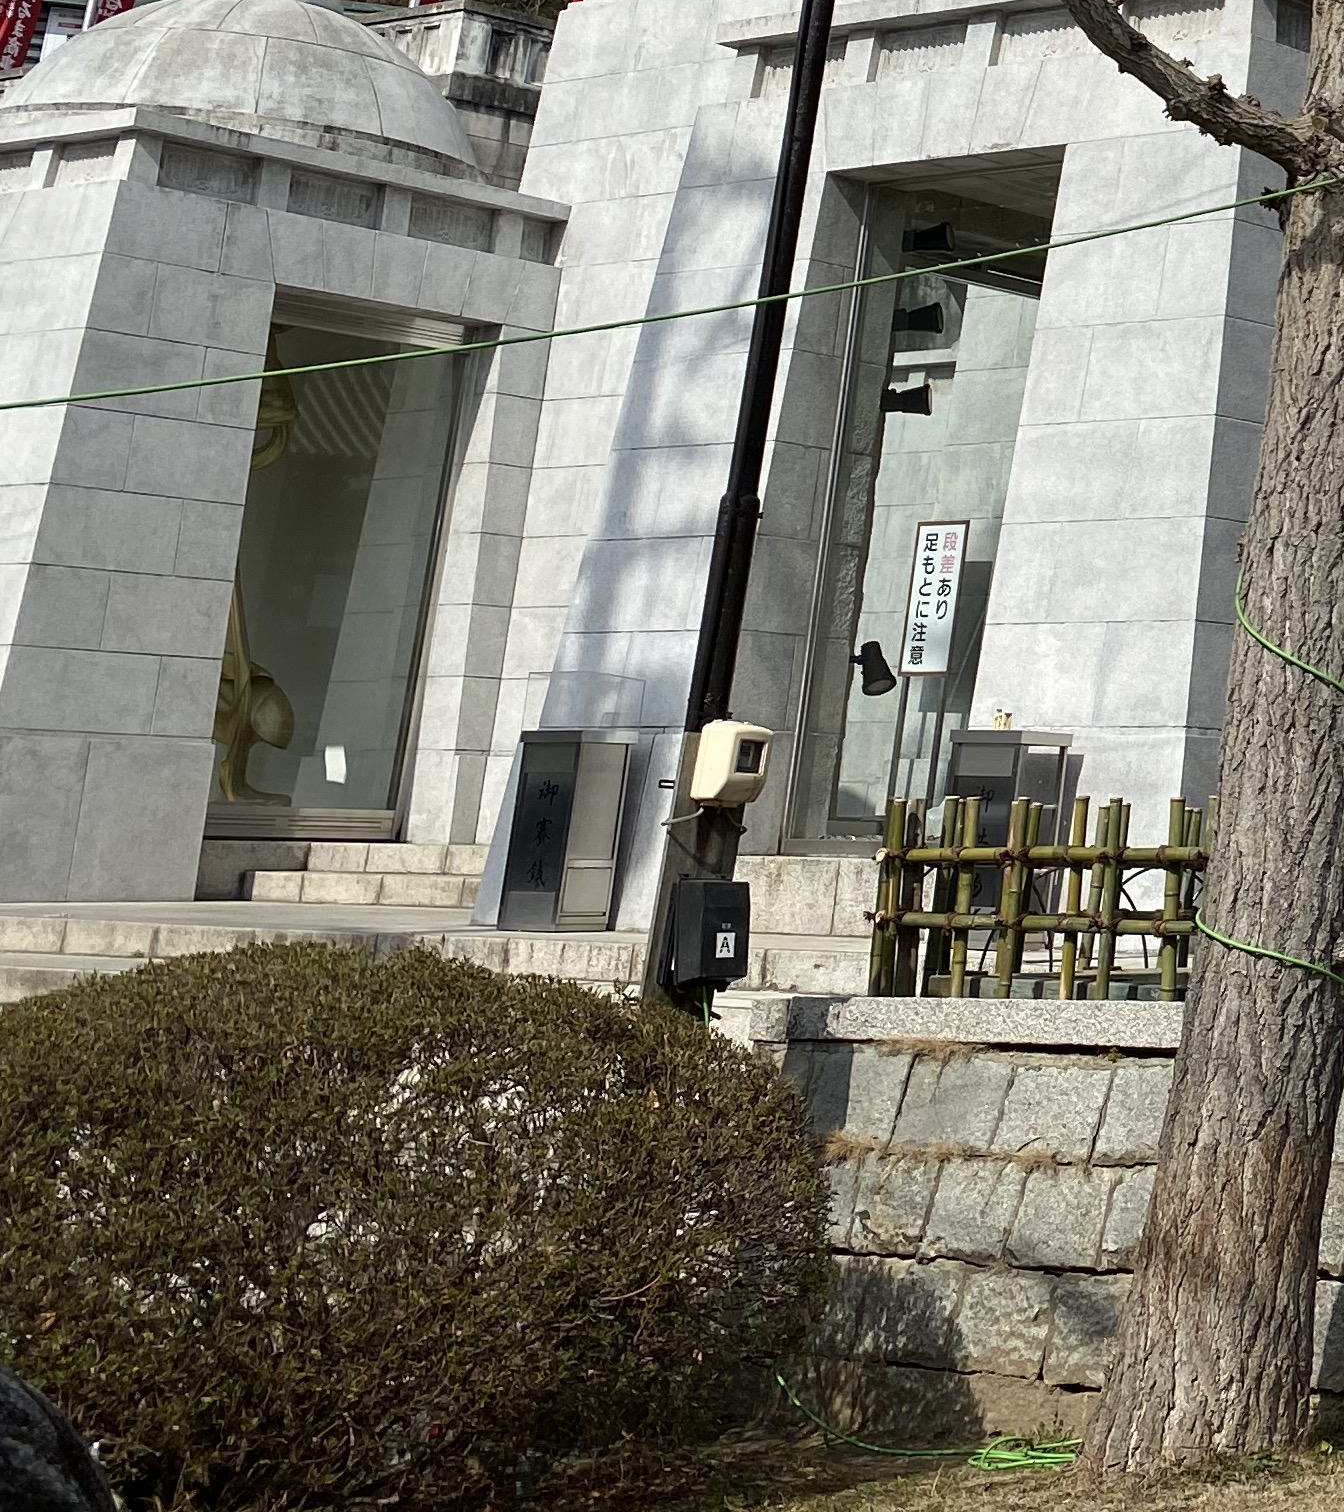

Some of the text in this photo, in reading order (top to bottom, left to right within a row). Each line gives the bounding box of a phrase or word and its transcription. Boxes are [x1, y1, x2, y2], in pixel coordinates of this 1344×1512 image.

[907, 532, 940, 666] 足もとに注意
[936, 532, 959, 621] 段差あり
